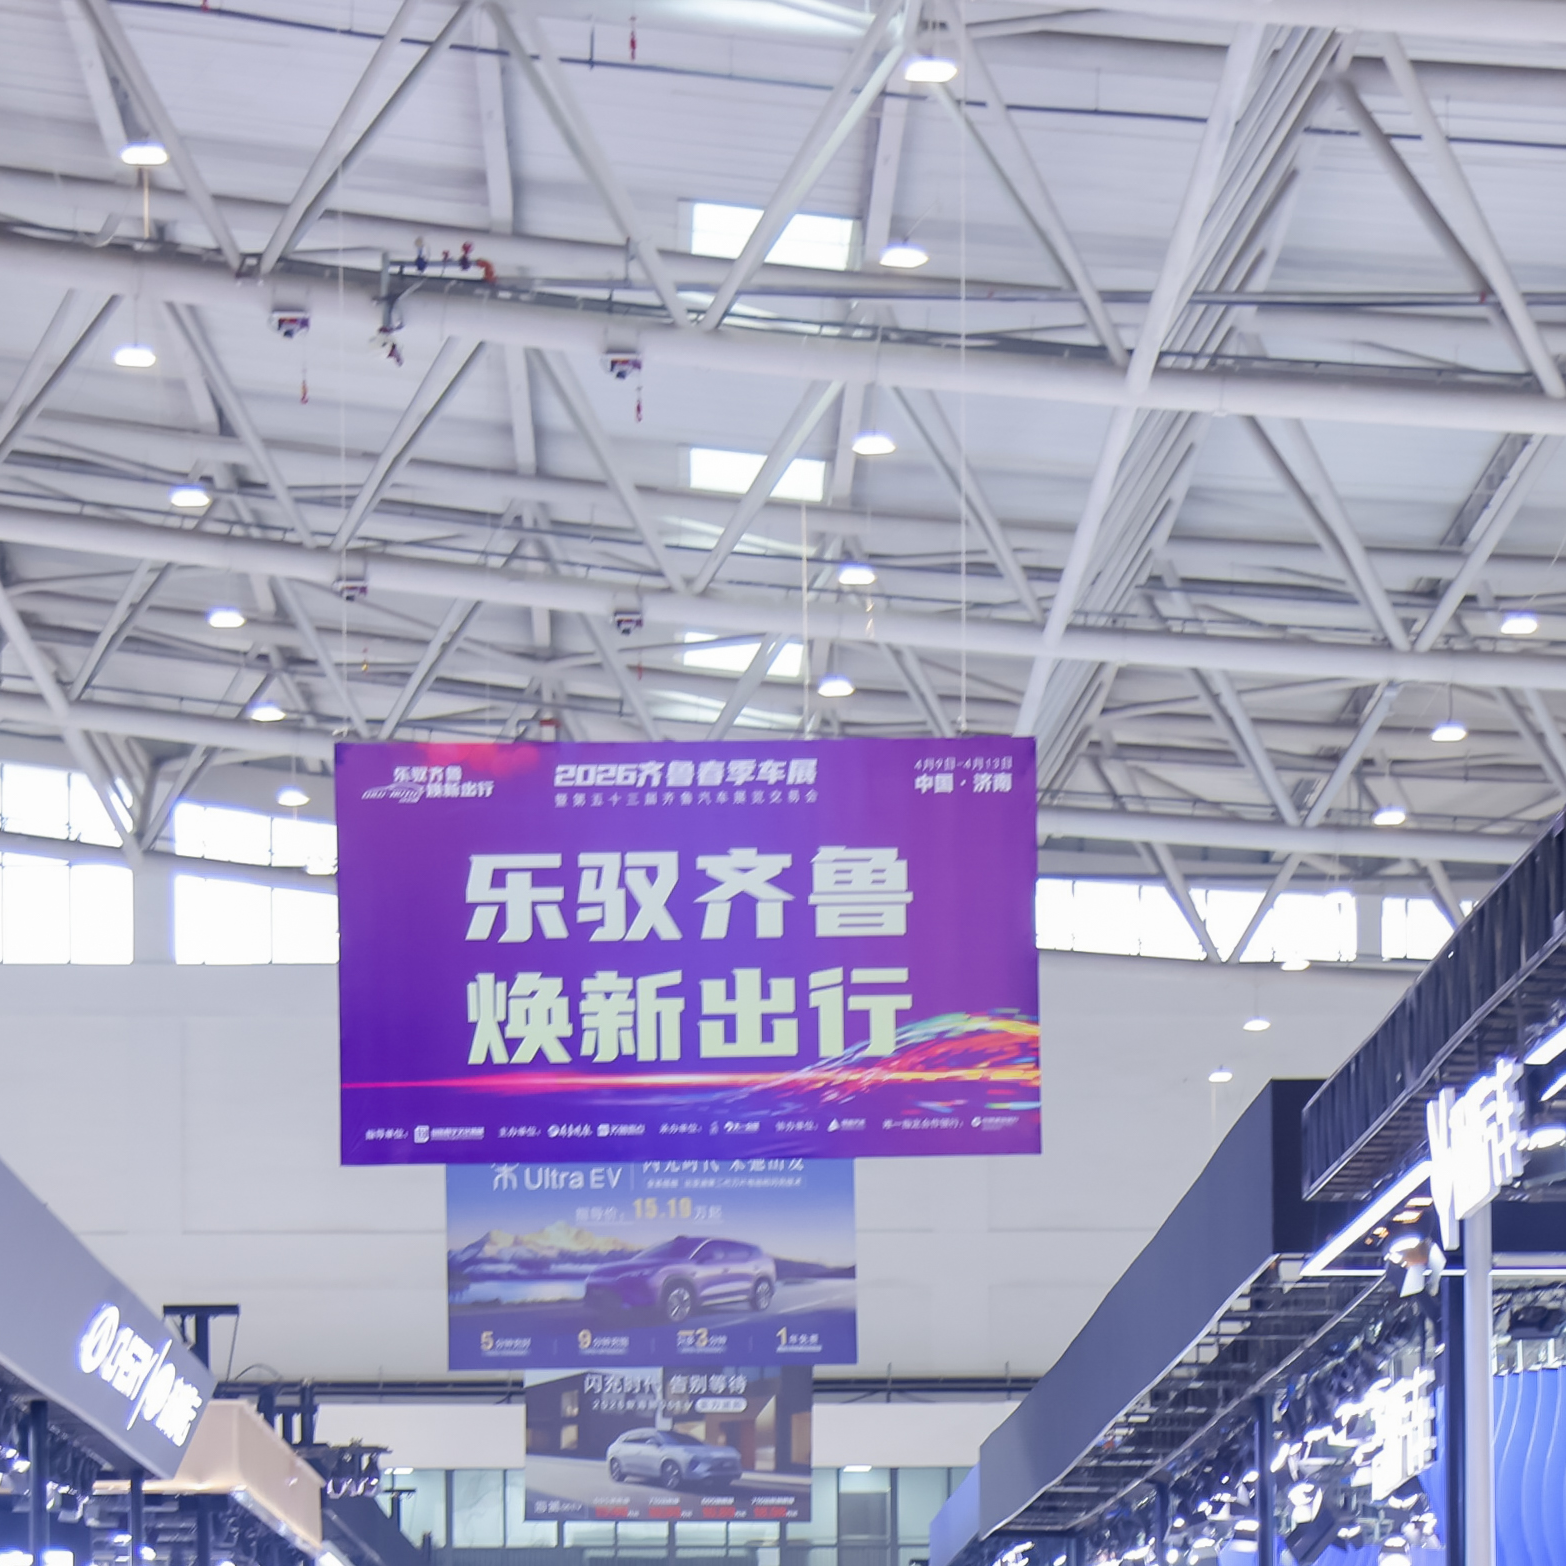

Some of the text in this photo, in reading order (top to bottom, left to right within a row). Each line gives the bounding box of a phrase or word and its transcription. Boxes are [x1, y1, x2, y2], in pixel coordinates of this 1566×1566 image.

[554, 758, 817, 787] 2026齐鲁春季车展
[465, 845, 913, 943] 乐驭齐鲁
[466, 966, 912, 1065] 焕新出行
[524, 1167, 584, 1190] Ultra
[589, 1167, 623, 1190] EV
